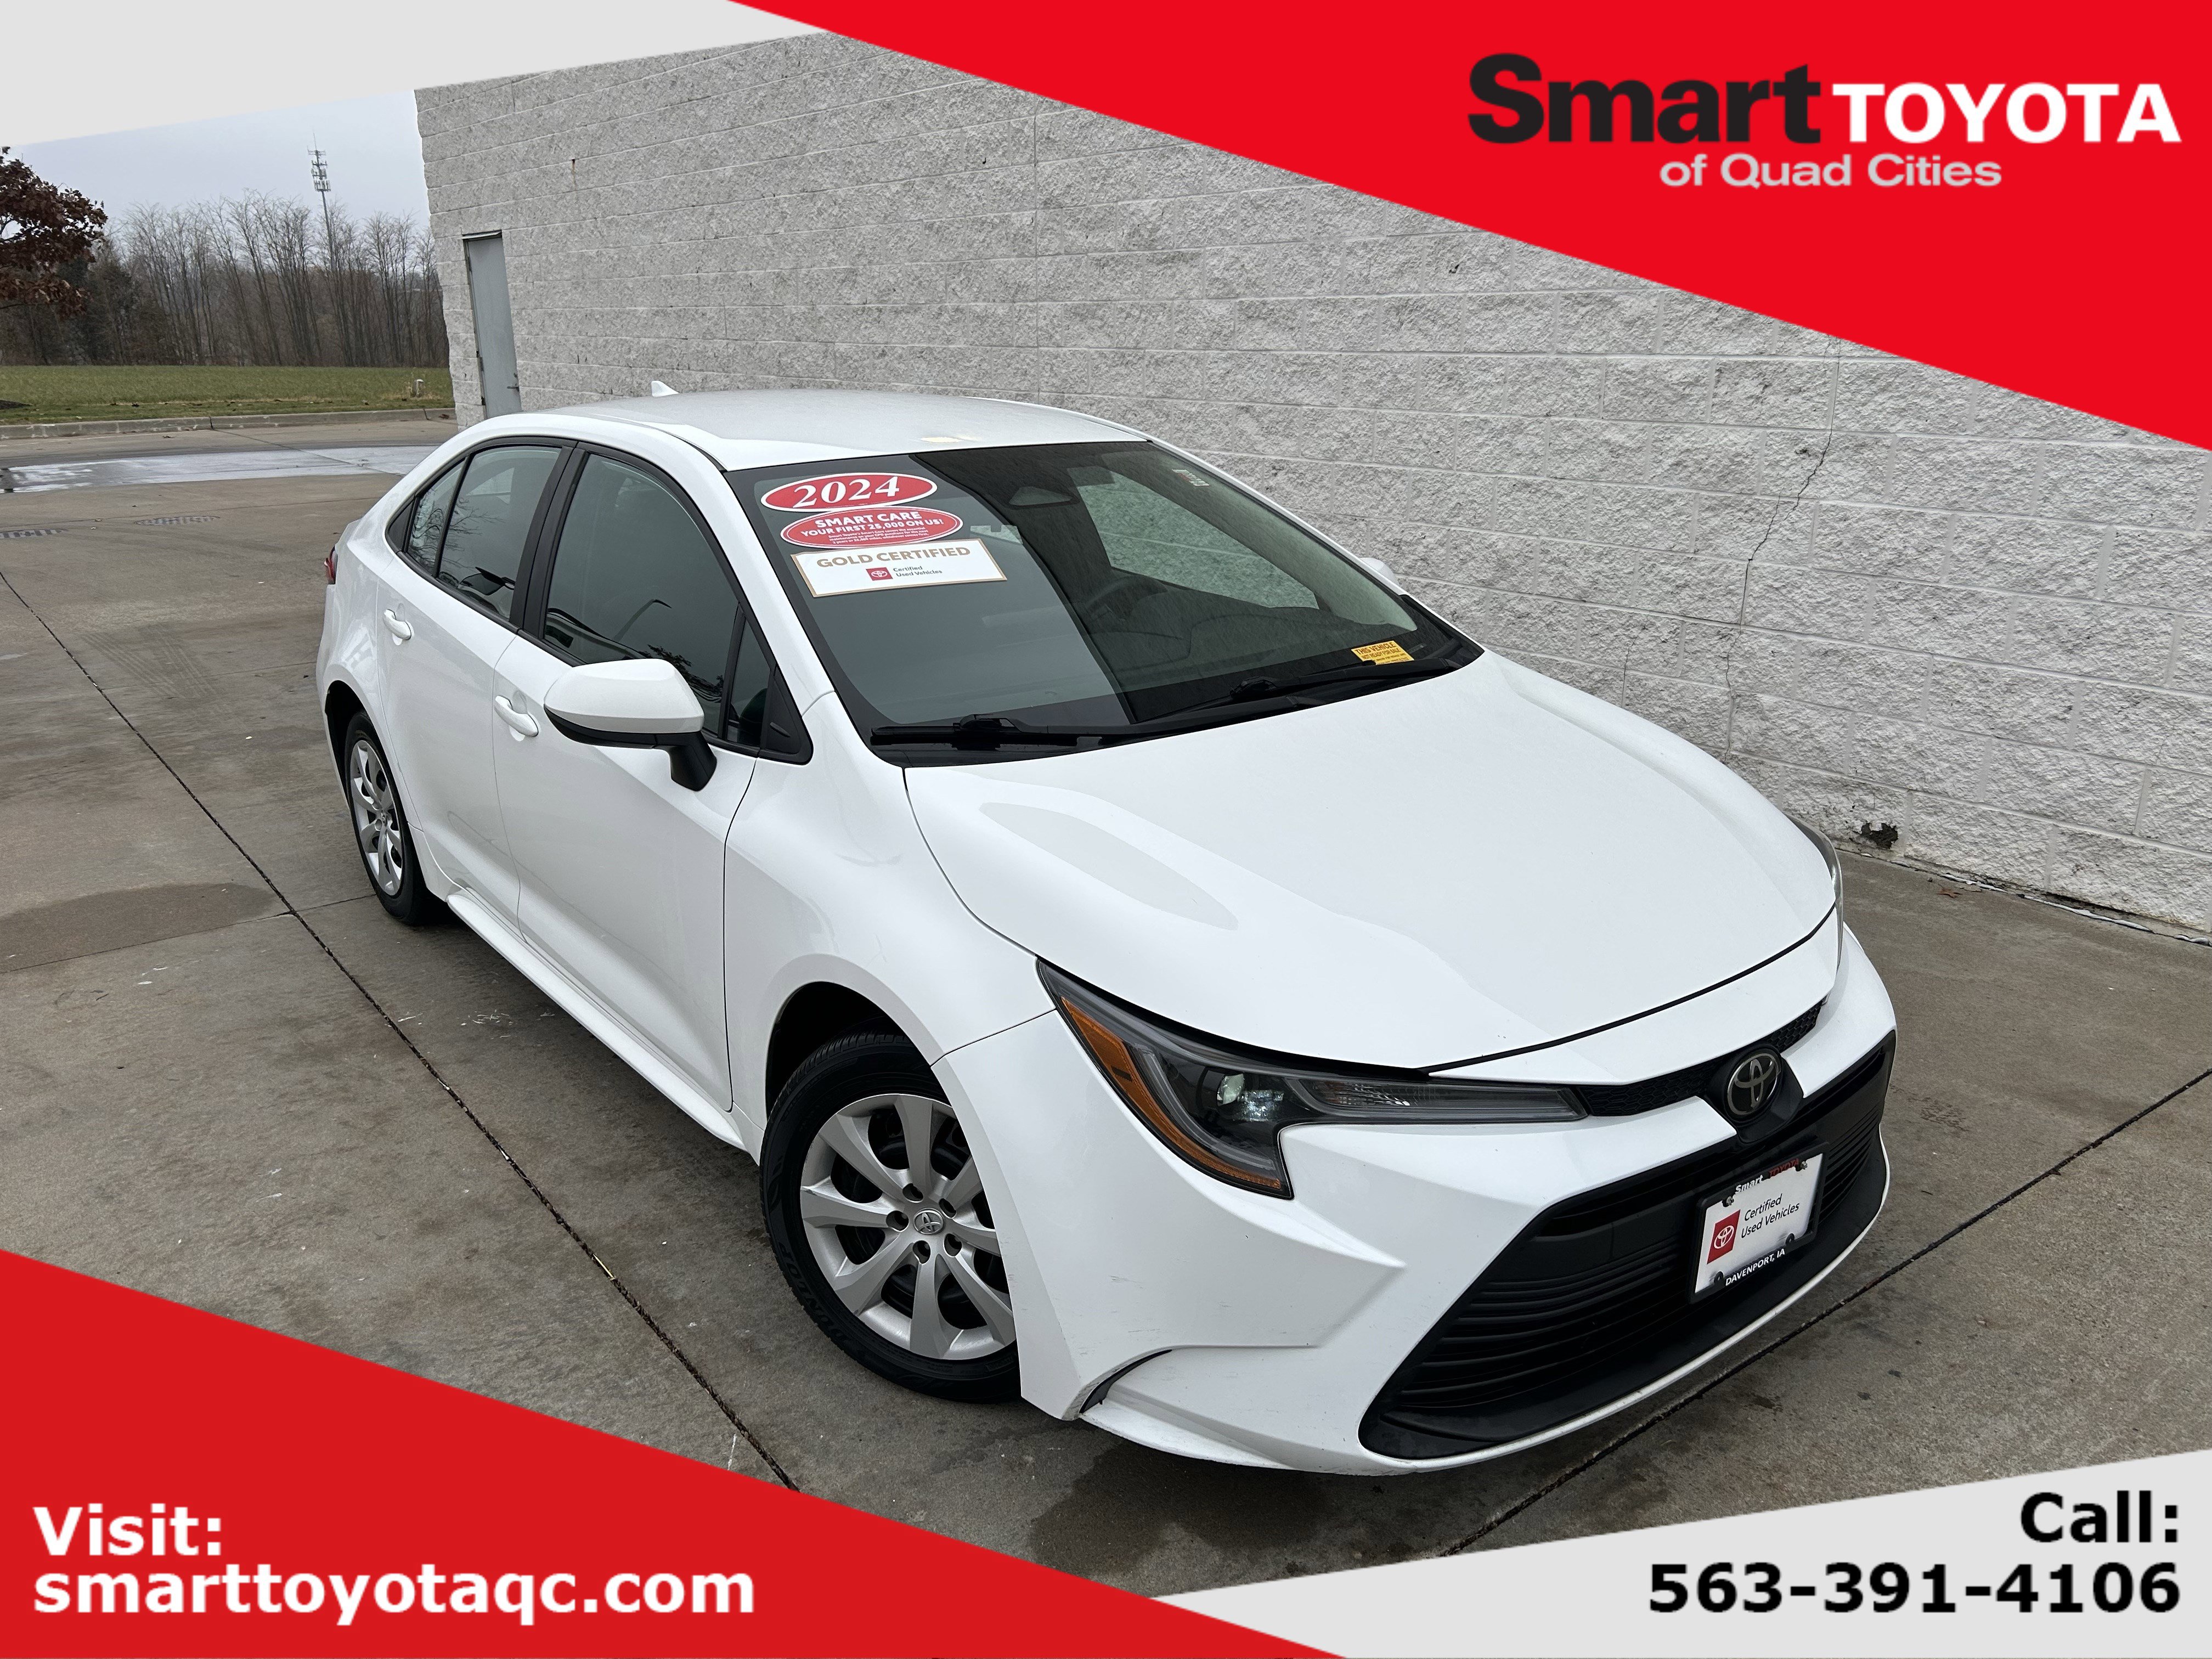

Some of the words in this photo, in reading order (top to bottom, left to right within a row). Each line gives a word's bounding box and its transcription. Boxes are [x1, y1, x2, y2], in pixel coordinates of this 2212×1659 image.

[793, 476, 899, 508] 2024
[801, 528, 835, 537] YOUR
[836, 525, 865, 533] FIRST
[815, 515, 873, 528] SMART
[877, 511, 922, 522] CARE
[817, 554, 873, 567] GOLD
[876, 547, 970, 561] CERTIFIED
[1355, 646, 1371, 654] THIS
[1369, 642, 1397, 652] VEHICLE
[1735, 1175, 1763, 1193] Smart
[1768, 1158, 1799, 1178] TOYOTA
[1741, 1217, 1763, 1238] Used
[1765, 1203, 1799, 1226] Vehicles
[1744, 1193, 1782, 1221] Certified
[1725, 1254, 1775, 1286] DAVENPORT,
[1777, 1248, 1785, 1258] IA
